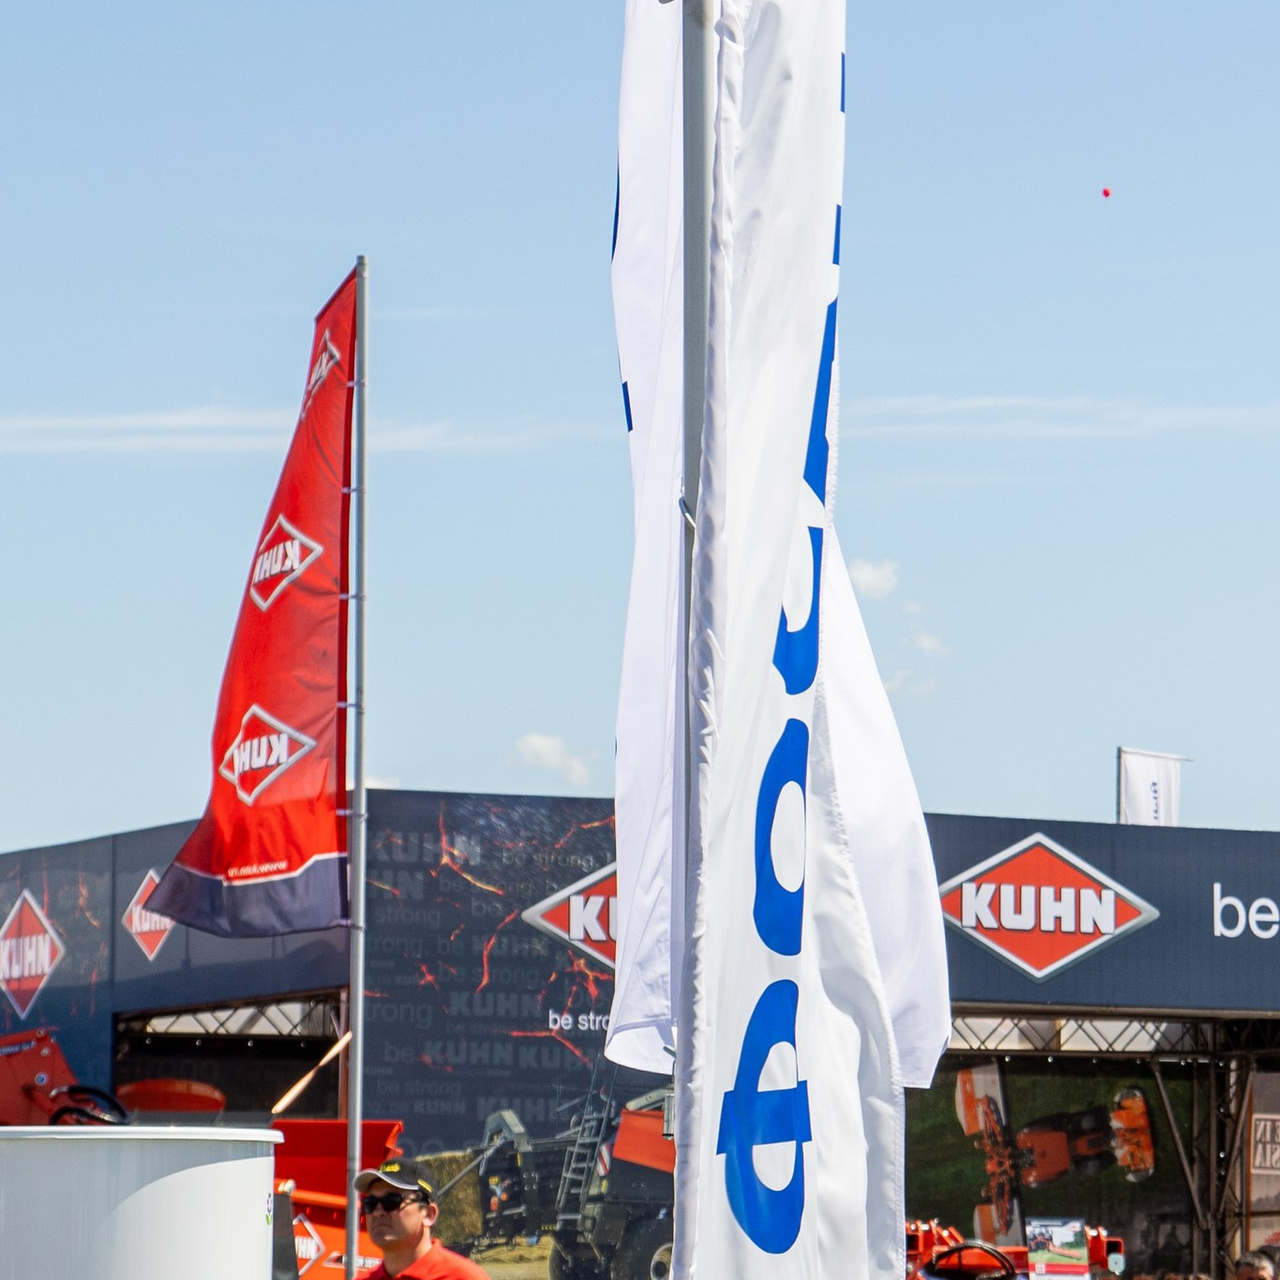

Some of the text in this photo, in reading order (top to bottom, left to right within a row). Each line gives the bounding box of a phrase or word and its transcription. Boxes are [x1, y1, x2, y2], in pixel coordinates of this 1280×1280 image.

[961, 881, 1116, 936] KUHN
[1212, 882, 1280, 941] be
[0, 932, 51, 980] KUHN
[548, 1008, 574, 1031] be
